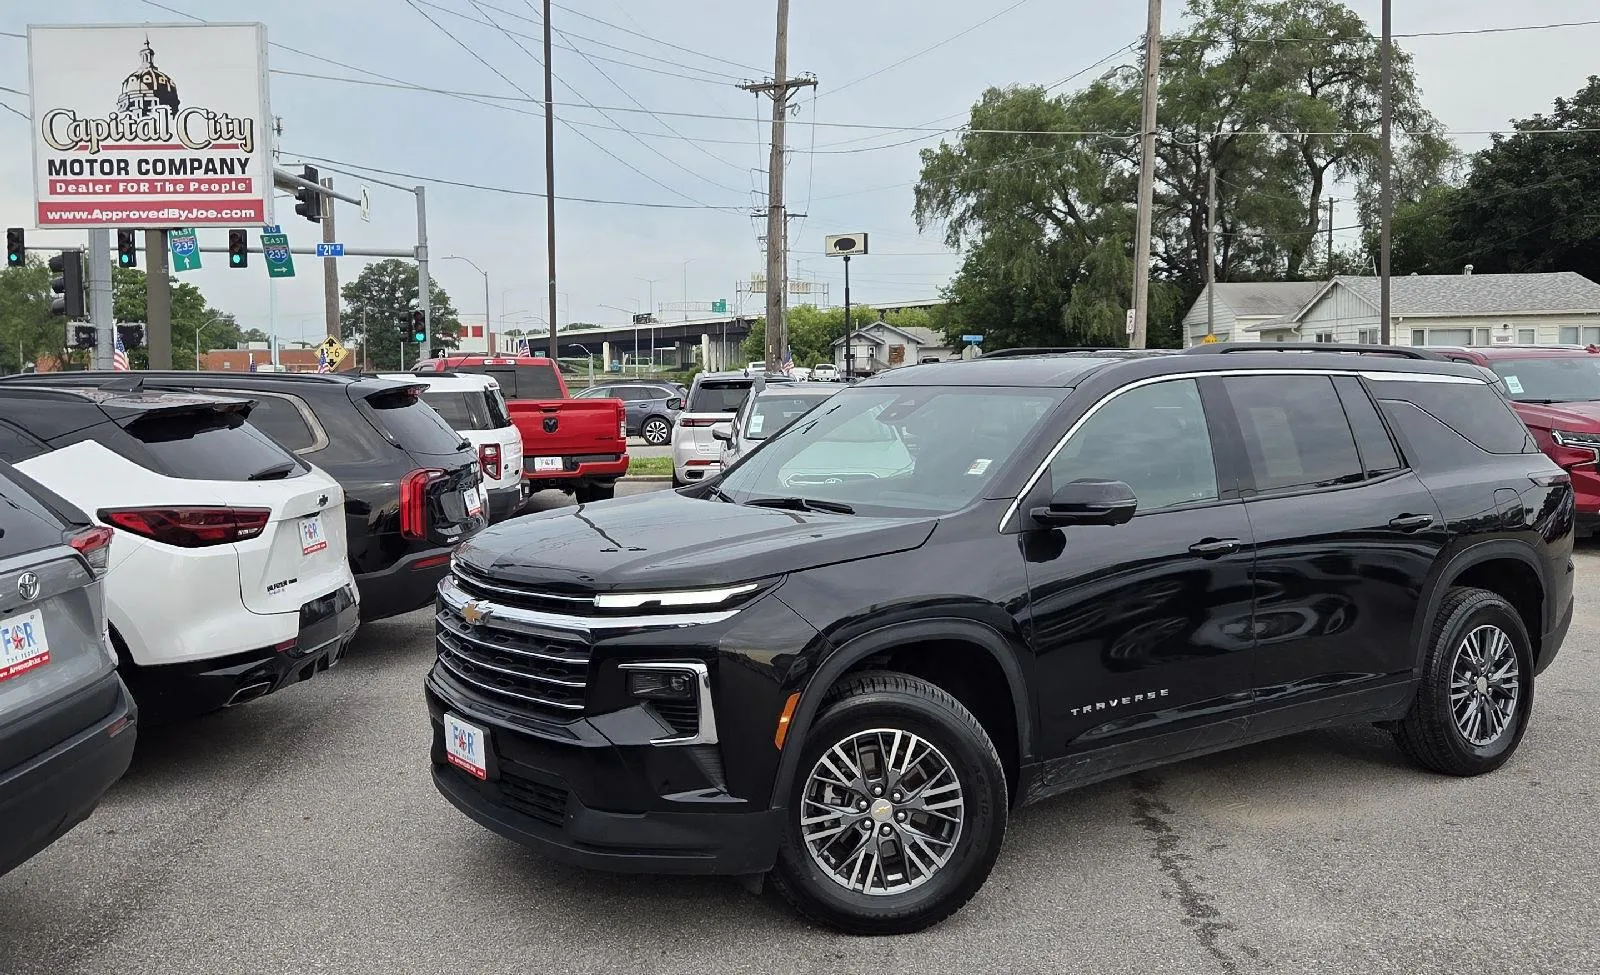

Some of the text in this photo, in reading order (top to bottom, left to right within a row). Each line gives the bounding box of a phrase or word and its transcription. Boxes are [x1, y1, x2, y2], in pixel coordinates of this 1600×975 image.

[42, 107, 253, 154] Capital City
[48, 157, 250, 176] MOTOR COMPANY
[56, 181, 246, 194] Dealer FOR The People
[47, 208, 255, 220] www.ApprovedByJoe.com
[175, 241, 194, 252] 235
[268, 249, 287, 259] 235
[1, 622, 38, 655] FOR
[1070, 689, 1169, 715] TRAVERSE
[453, 724, 475, 756] FOR
